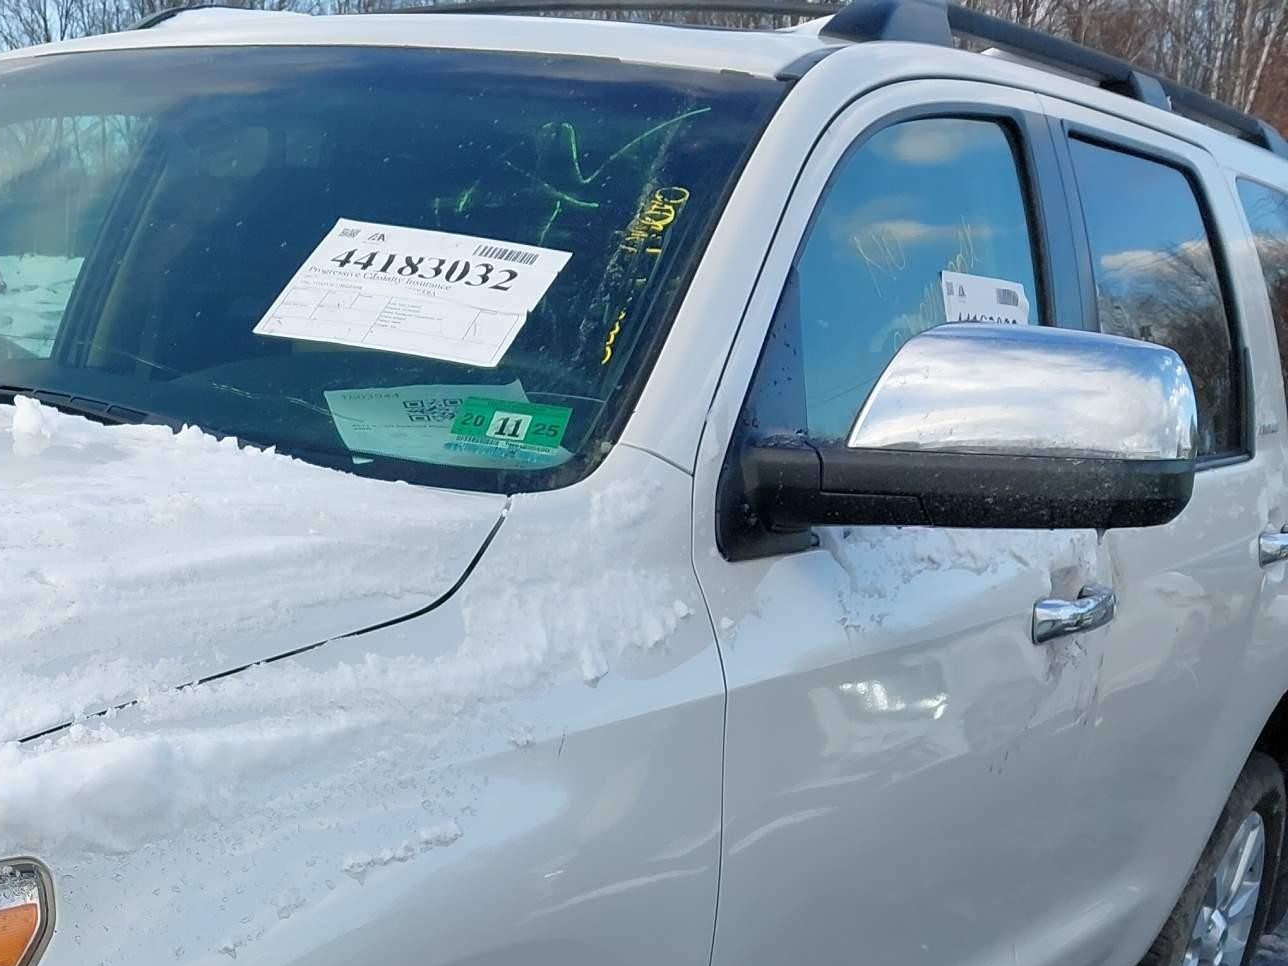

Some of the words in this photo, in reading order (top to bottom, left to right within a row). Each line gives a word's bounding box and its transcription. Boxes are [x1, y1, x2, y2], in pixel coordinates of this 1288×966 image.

[308, 266, 362, 280] Progressive
[405, 277, 452, 291] Insurance
[330, 248, 519, 292] 44183032
[461, 412, 486, 428] 20
[494, 416, 523, 438] 11
[532, 422, 560, 438] 25
